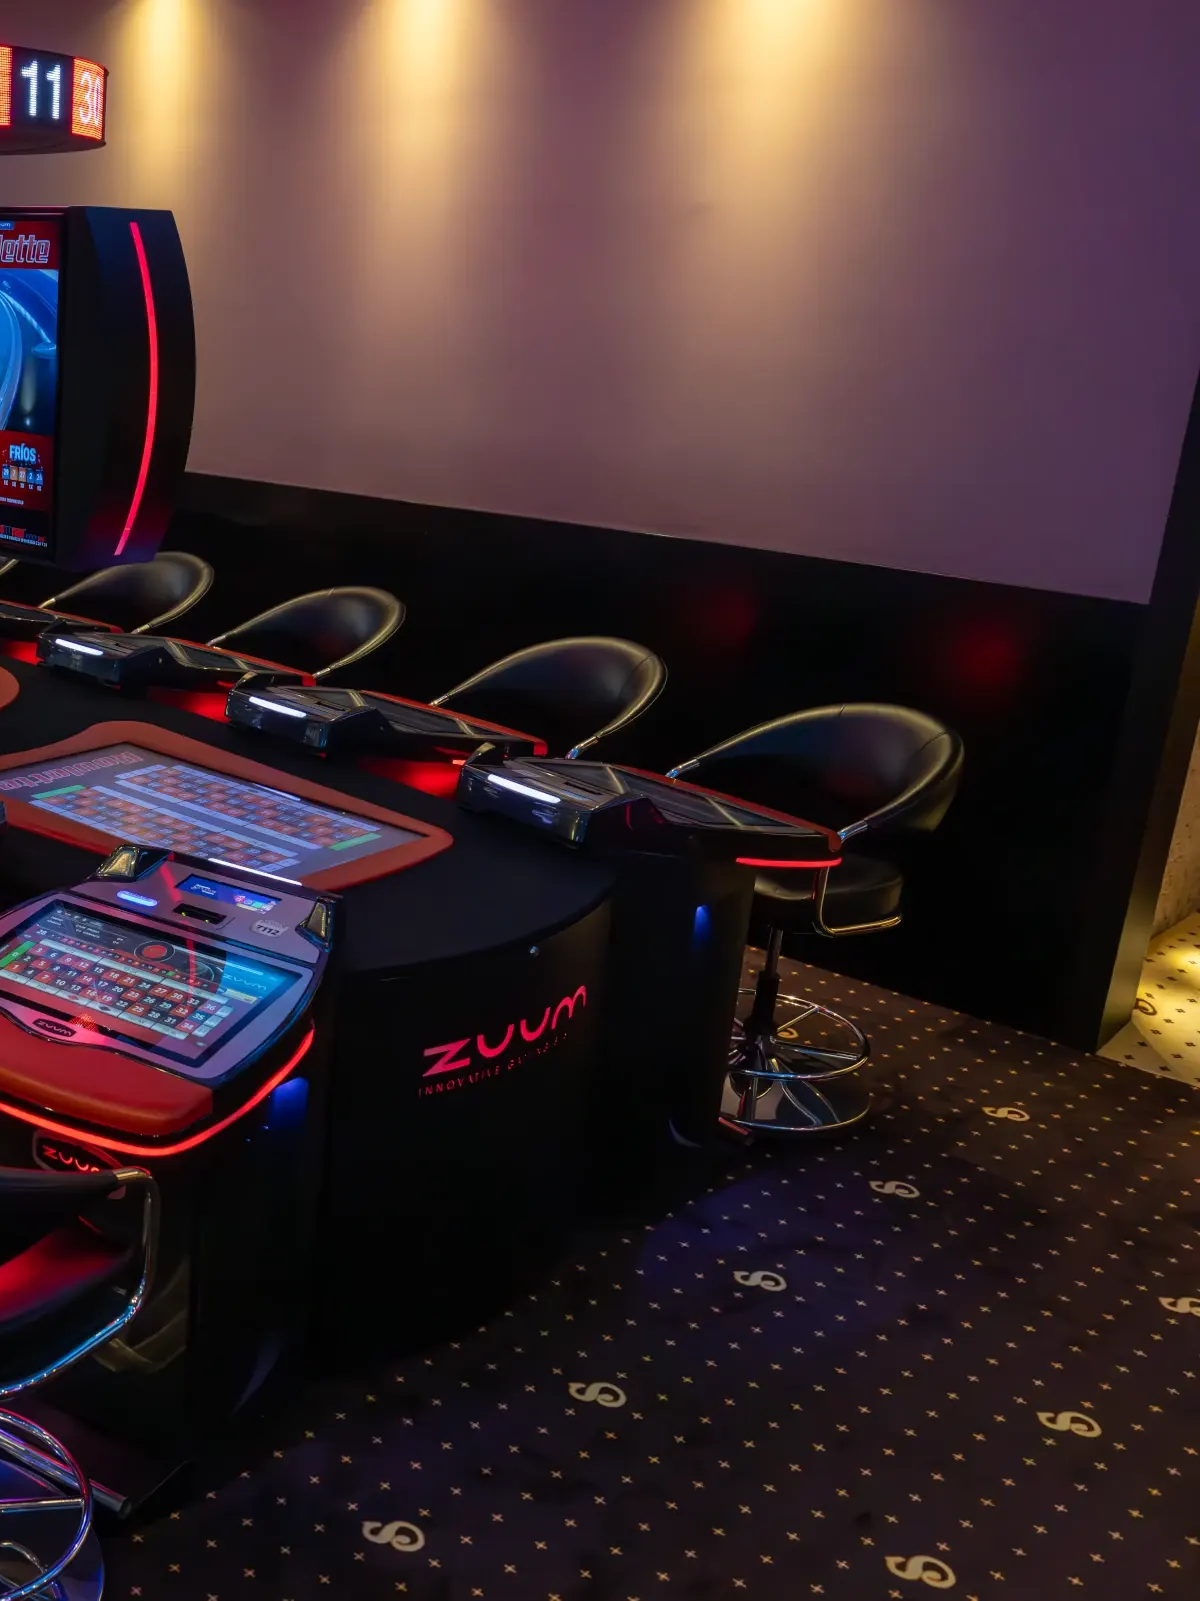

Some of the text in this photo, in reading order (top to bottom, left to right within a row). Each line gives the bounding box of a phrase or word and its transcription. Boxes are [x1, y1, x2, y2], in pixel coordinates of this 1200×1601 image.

[20, 59, 61, 120] 11
[79, 71, 102, 127] 30
[9, 443, 37, 464] FRÍOS
[257, 924, 280, 936] 7112
[85, 989, 97, 997] 16
[115, 1000, 129, 1008] 22
[131, 1005, 145, 1013] 25
[147, 1011, 161, 1019] 28
[180, 1022, 194, 1030] 34
[111, 985, 124, 993] 20
[143, 996, 155, 1004] 26
[159, 1001, 172, 1009] 29
[175, 1007, 189, 1015] 32
[192, 1012, 204, 1021] 35
[123, 976, 136, 984] 21
[171, 992, 183, 1000] 30
[203, 1003, 216, 1011] 36
[37, 1021, 72, 1036] zuum
[422, 985, 587, 1078] zuum
[418, 1065, 500, 1098] INNOVATIVE
